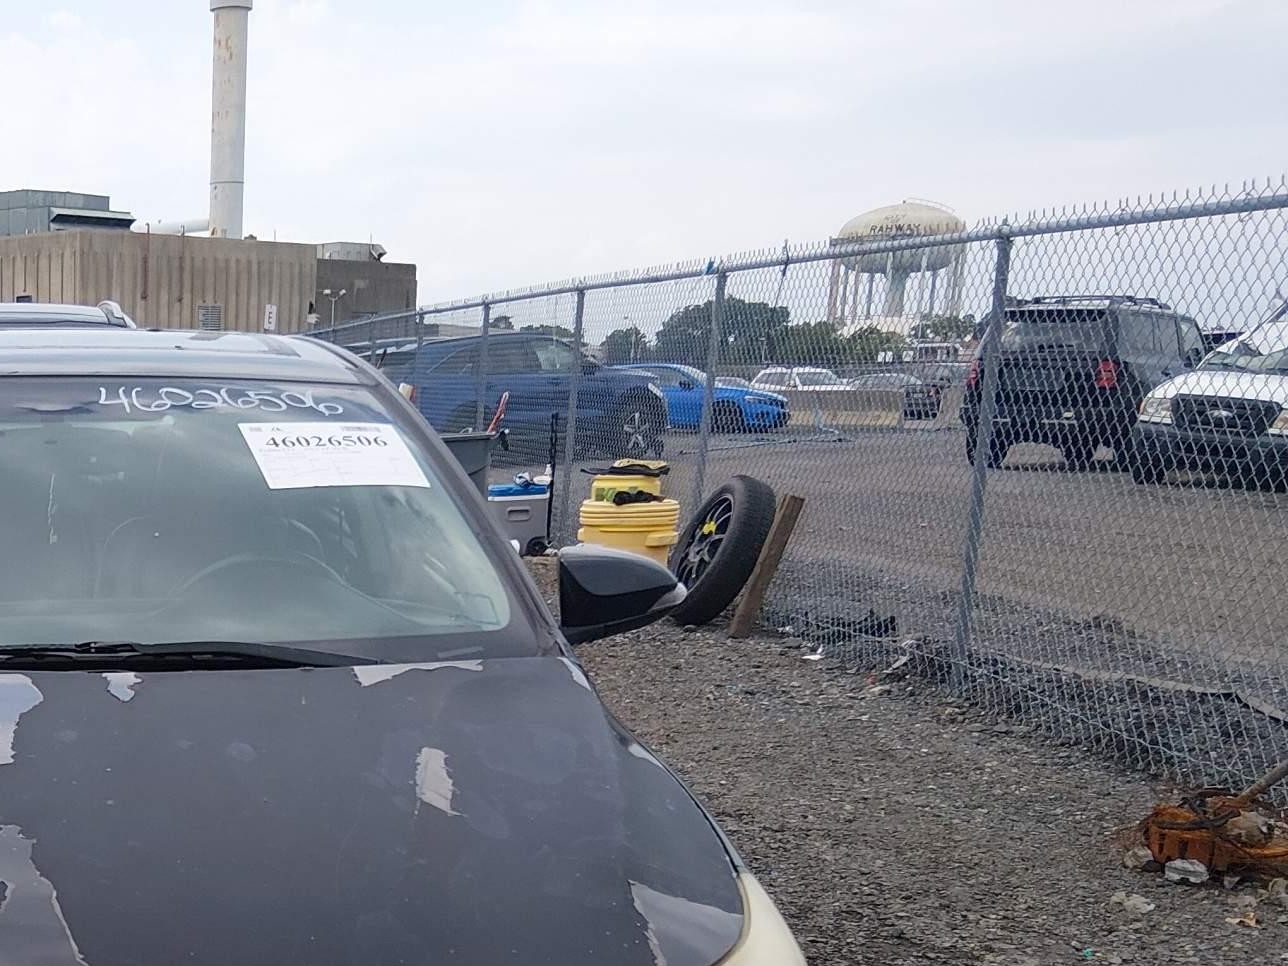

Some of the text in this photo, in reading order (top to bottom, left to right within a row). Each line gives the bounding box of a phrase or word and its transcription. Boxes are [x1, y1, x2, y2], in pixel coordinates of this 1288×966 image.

[870, 223, 921, 236] RAHWAY
[98, 386, 344, 416] 46026506
[265, 435, 389, 448] 46026506
